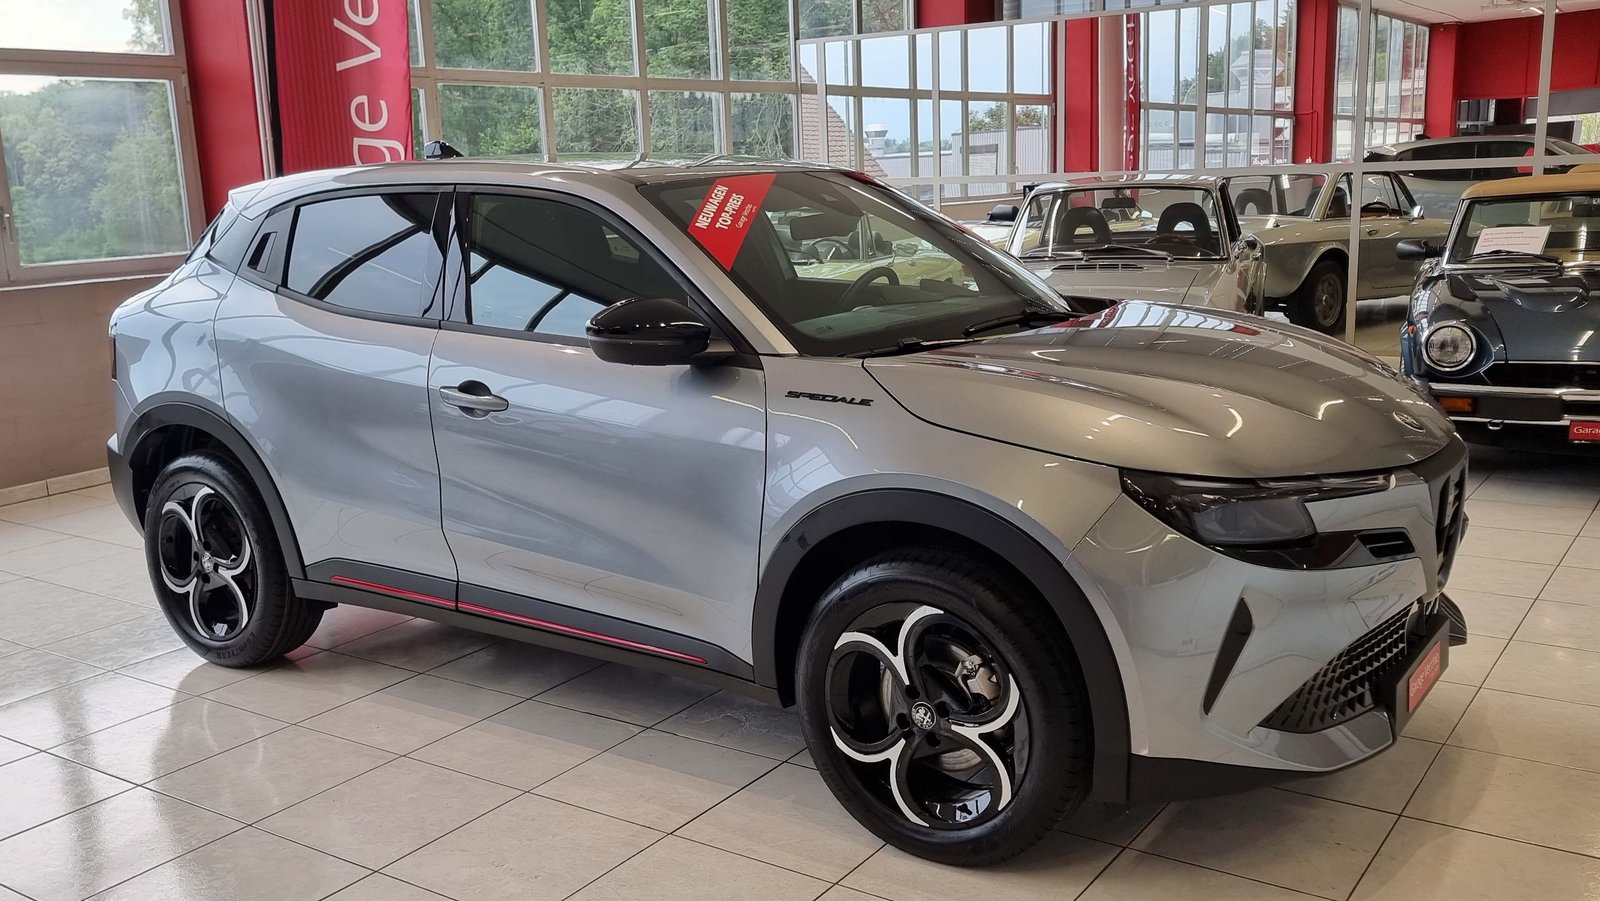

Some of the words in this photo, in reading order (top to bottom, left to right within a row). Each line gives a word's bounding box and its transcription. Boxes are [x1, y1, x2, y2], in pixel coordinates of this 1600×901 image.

[695, 184, 729, 230] NEUWAGEN
[715, 193, 745, 230] TOP-PREIS
[784, 390, 874, 407] SPECIALE
